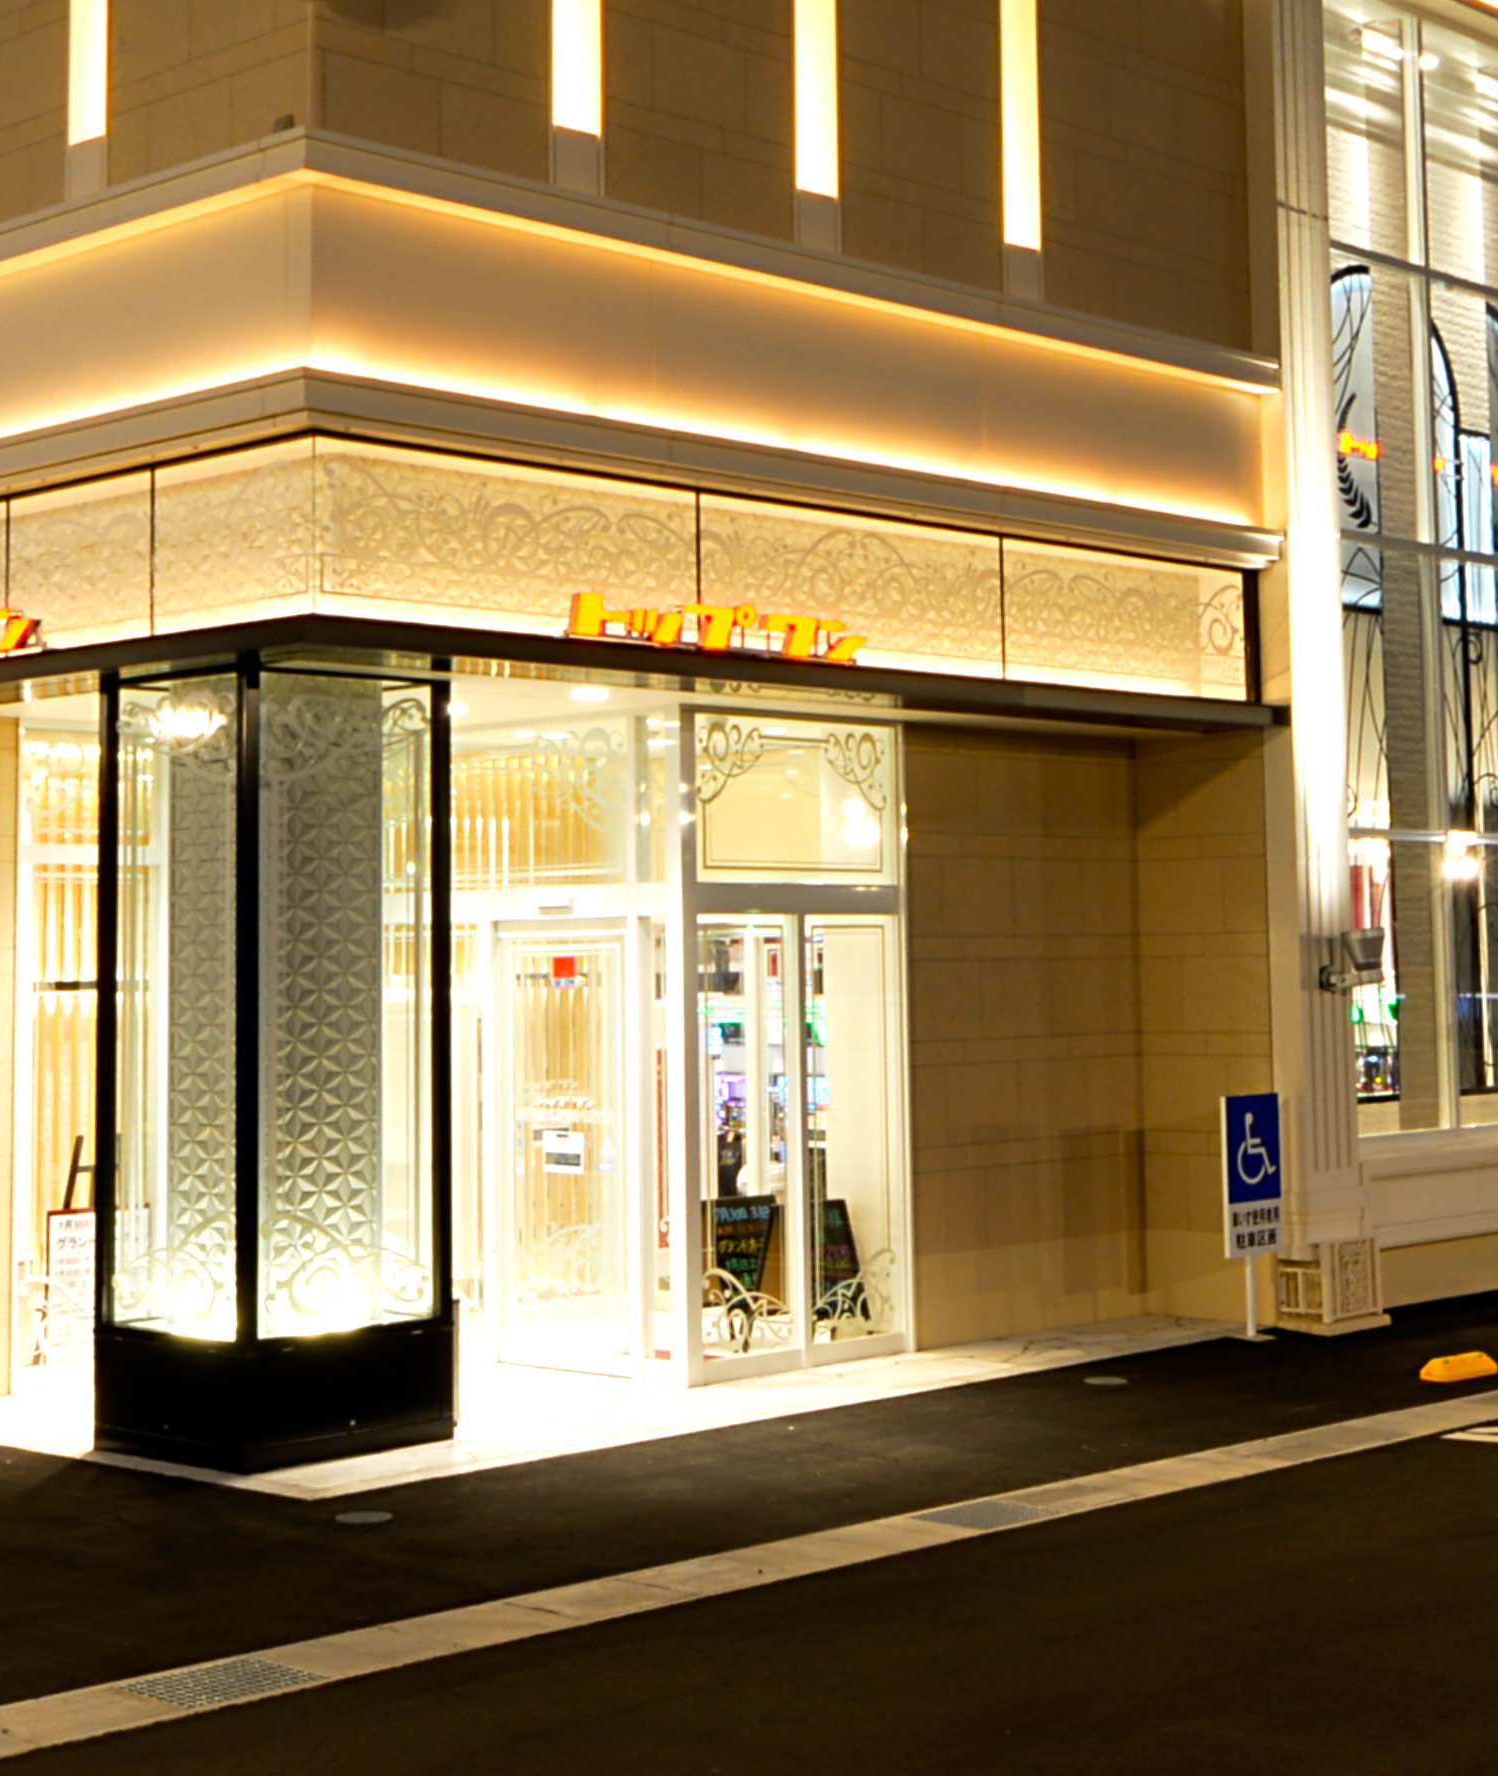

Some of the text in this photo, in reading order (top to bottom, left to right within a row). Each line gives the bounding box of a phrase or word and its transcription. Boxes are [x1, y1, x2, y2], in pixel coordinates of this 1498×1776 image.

[570, 591, 868, 662] トップワン
